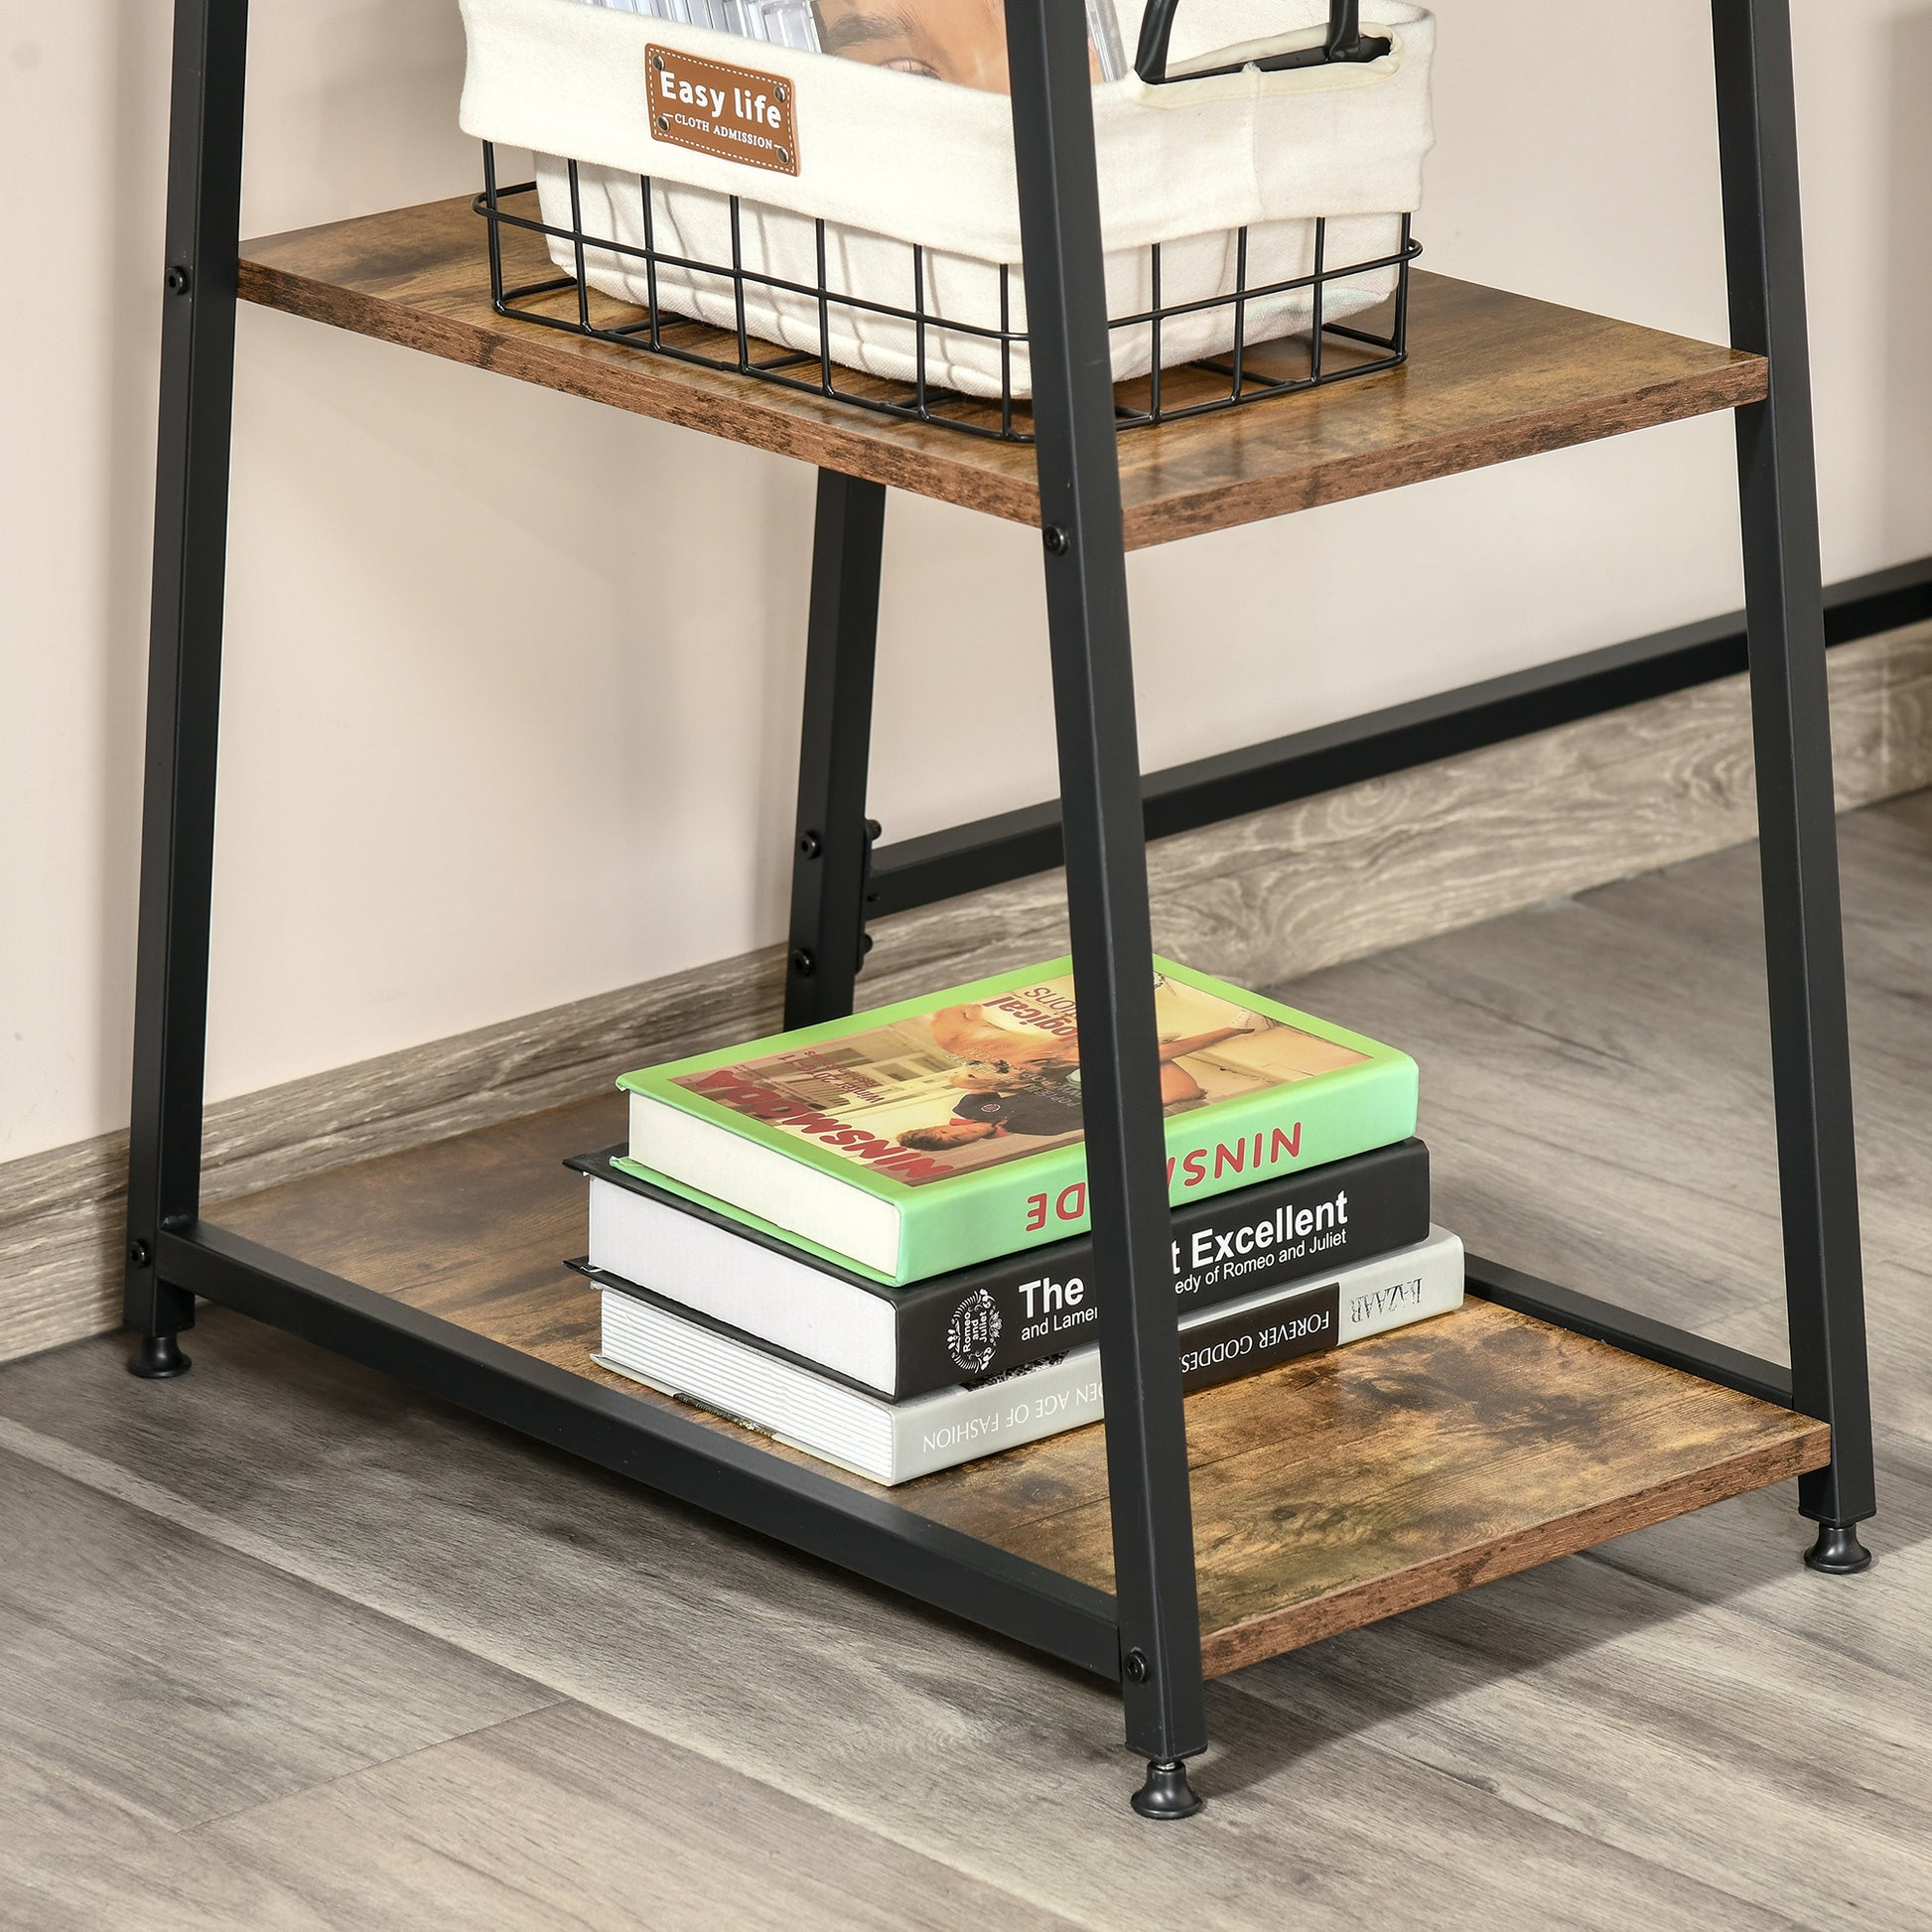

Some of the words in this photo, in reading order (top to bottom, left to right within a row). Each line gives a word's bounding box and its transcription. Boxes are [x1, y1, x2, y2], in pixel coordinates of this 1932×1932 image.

[659, 70, 726, 118] Easy
[734, 87, 781, 129] life
[674, 113, 710, 132] CLOTH
[713, 125, 773, 150] ADMISSION
[834, 1082, 885, 1104] Winter
[696, 1070, 954, 1178] NINSMODA
[1167, 1122, 1302, 1189] NINS
[1018, 1277, 1085, 1318] The
[1191, 1190, 1348, 1269] Excellent
[1021, 1317, 1049, 1341] and
[1053, 1307, 1097, 1331] Lame
[1204, 1265, 1220, 1286] of
[1223, 1253, 1275, 1281] Romeo
[1279, 1240, 1306, 1263] and
[1309, 1228, 1347, 1254] Juliet
[1349, 1277, 1423, 1324] BAZAAR
[962, 1311, 972, 1353] Romeo
[971, 1318, 980, 1340] and
[979, 1311, 988, 1342] Juliet
[1259, 1311, 1330, 1349] FOREVER
[1178, 1334, 1253, 1374] GODDES
[1006, 1404, 1030, 1428] OF
[1035, 1390, 1070, 1419] AGE
[922, 1412, 999, 1453] FASHION
